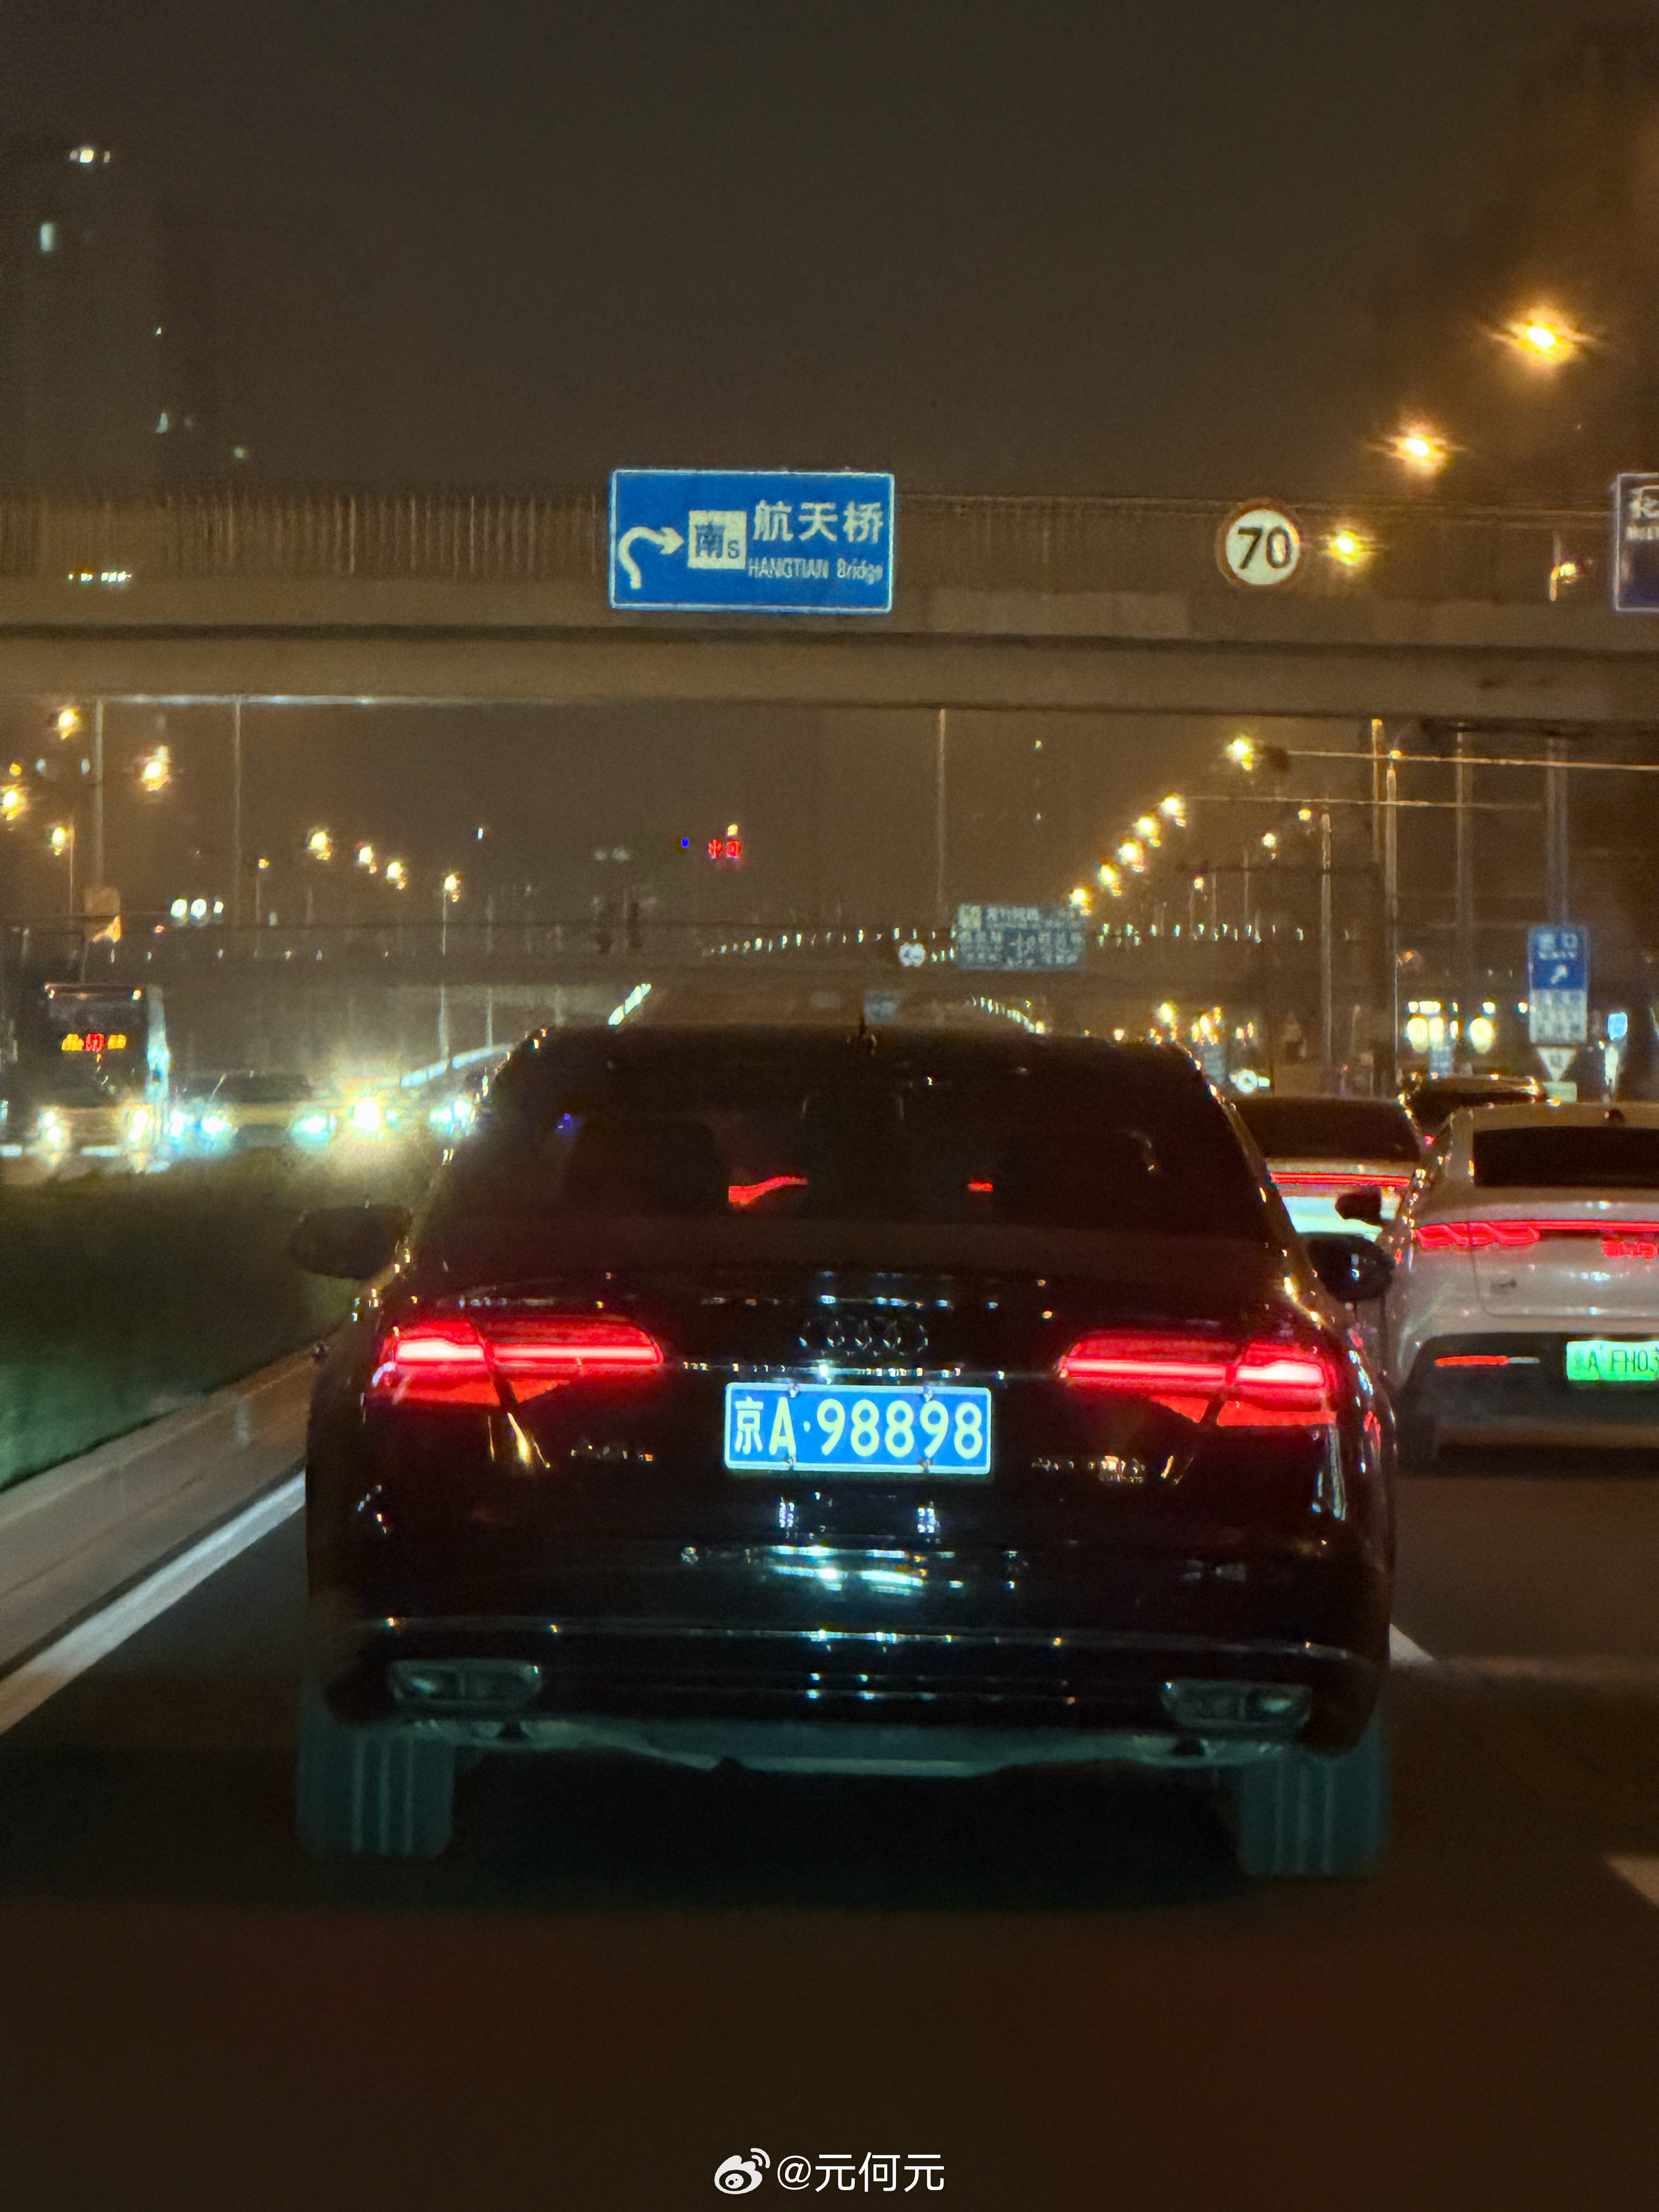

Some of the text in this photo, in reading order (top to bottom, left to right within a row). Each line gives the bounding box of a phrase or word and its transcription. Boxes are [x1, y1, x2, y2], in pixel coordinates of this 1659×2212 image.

[753, 499, 883, 543] 航天桥
[1238, 527, 1291, 569] 70
[734, 1396, 983, 1460] 京A·98898
